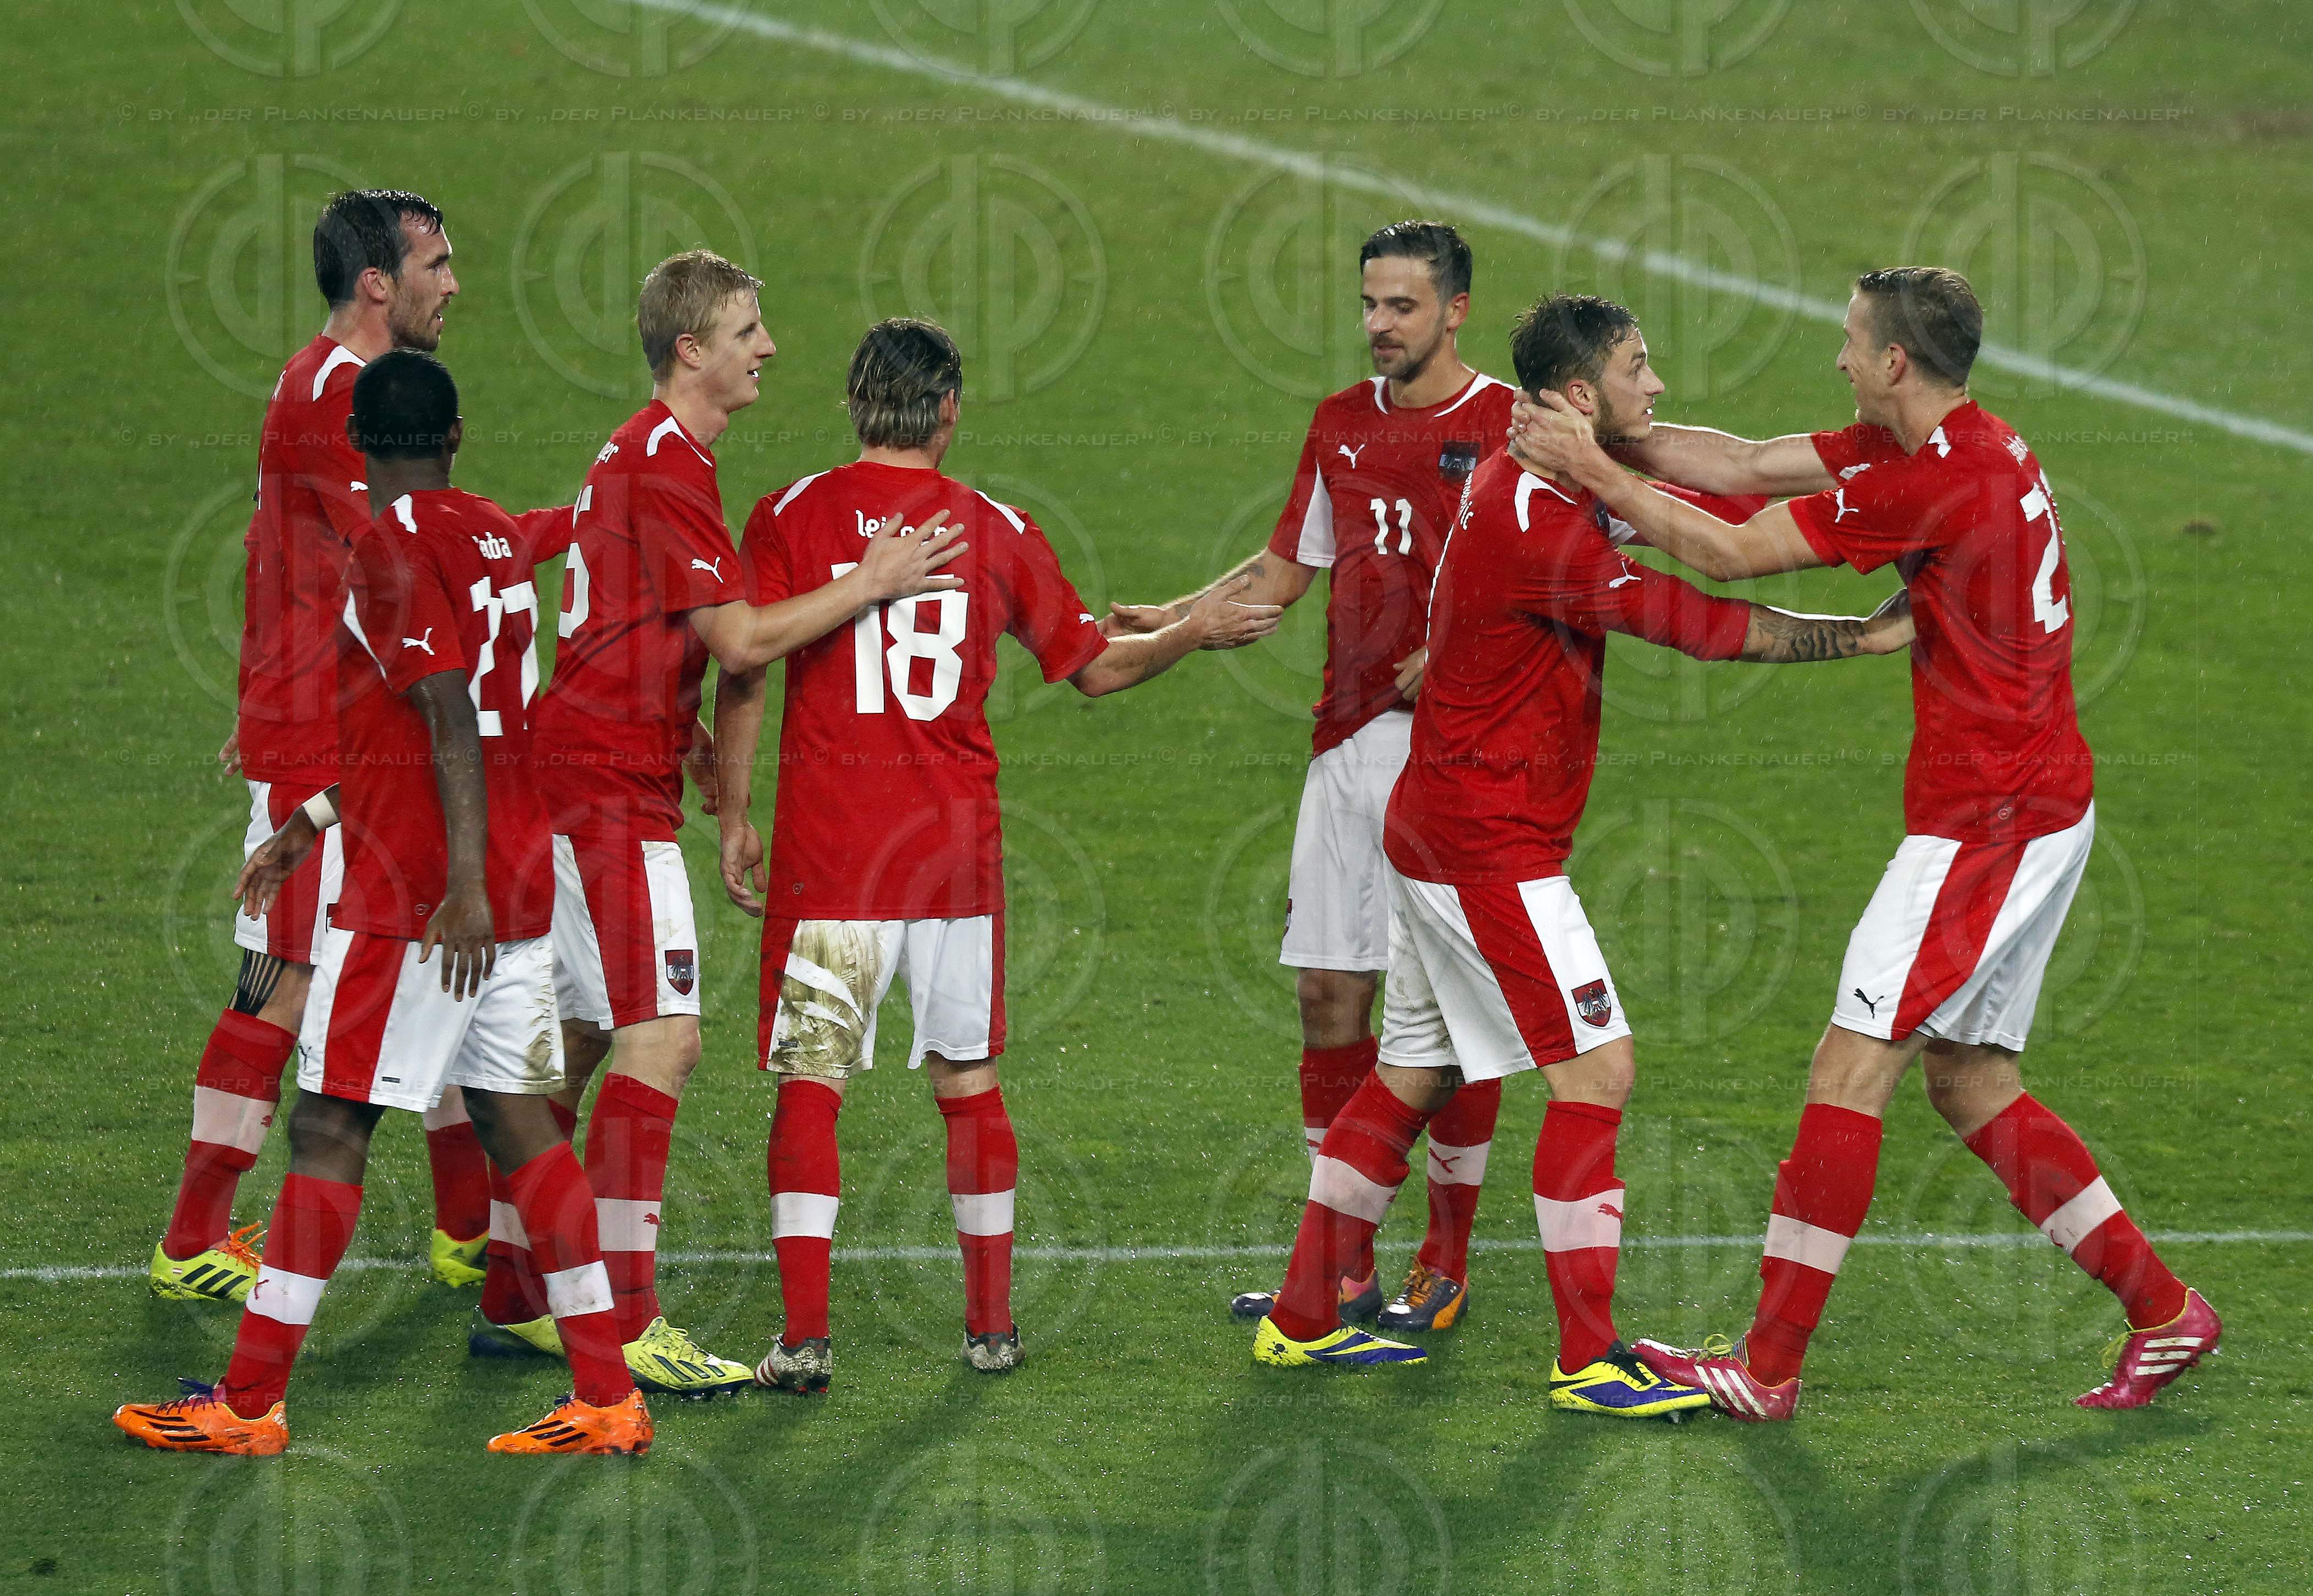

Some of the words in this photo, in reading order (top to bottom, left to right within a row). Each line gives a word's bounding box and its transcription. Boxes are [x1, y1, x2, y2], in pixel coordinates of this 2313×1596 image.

[1370, 498, 1413, 556] 11
[469, 576, 540, 736] 27
[831, 562, 970, 722] 18
